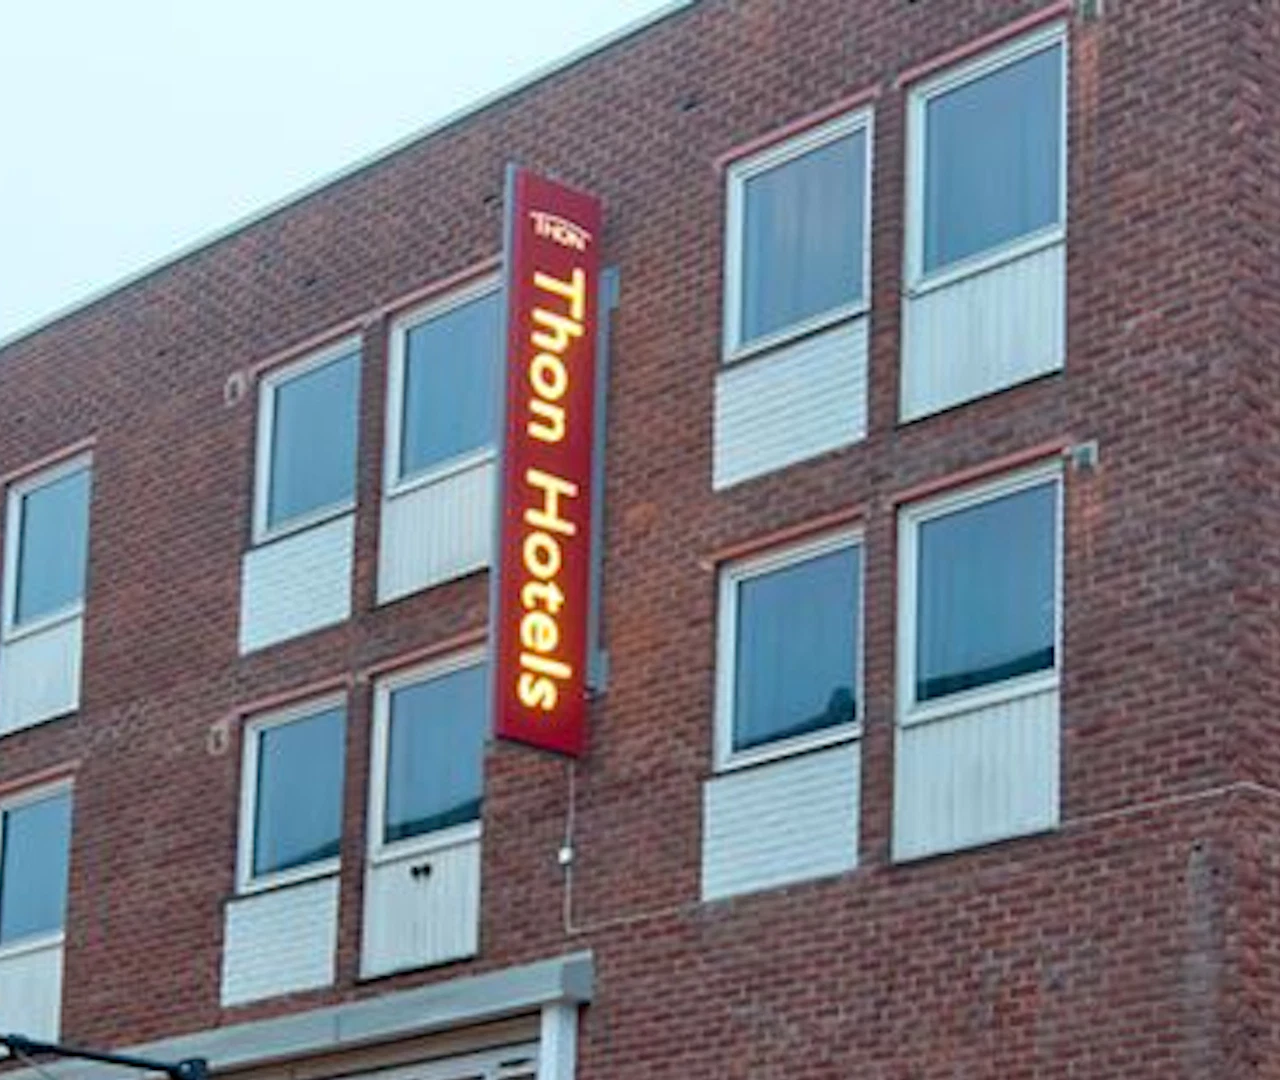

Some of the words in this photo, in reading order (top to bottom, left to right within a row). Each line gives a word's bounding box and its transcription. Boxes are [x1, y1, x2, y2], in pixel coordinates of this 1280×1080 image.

[529, 210, 593, 252] THON
[526, 267, 586, 444] Thon
[517, 468, 579, 712] Hotels
